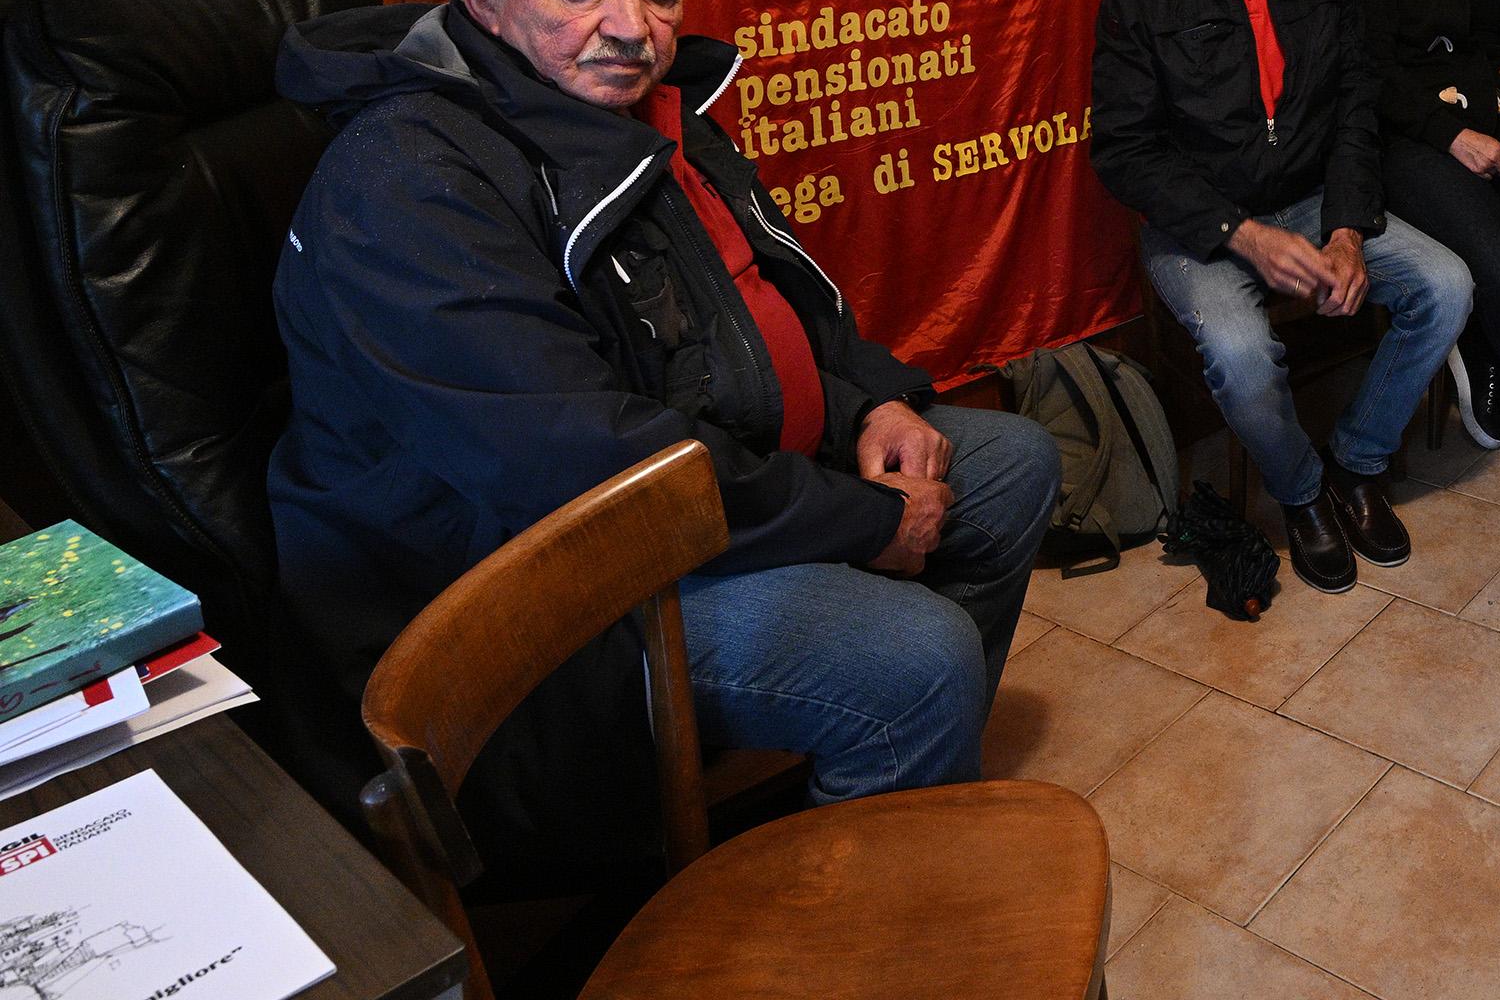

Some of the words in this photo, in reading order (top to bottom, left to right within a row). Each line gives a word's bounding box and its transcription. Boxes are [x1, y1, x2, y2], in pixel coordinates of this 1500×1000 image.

[736, 36, 975, 124] pensionati
[741, 88, 921, 160] italiani
[770, 172, 844, 224] ega
[873, 149, 915, 195] di
[0, 833, 46, 854] GIL
[52, 809, 127, 842] SINDACATO
[0, 843, 51, 871] SPI
[55, 812, 132, 847] PENSIONATI
[58, 826, 111, 851] ITALIANI
[145, 946, 242, 1000] igliore”
